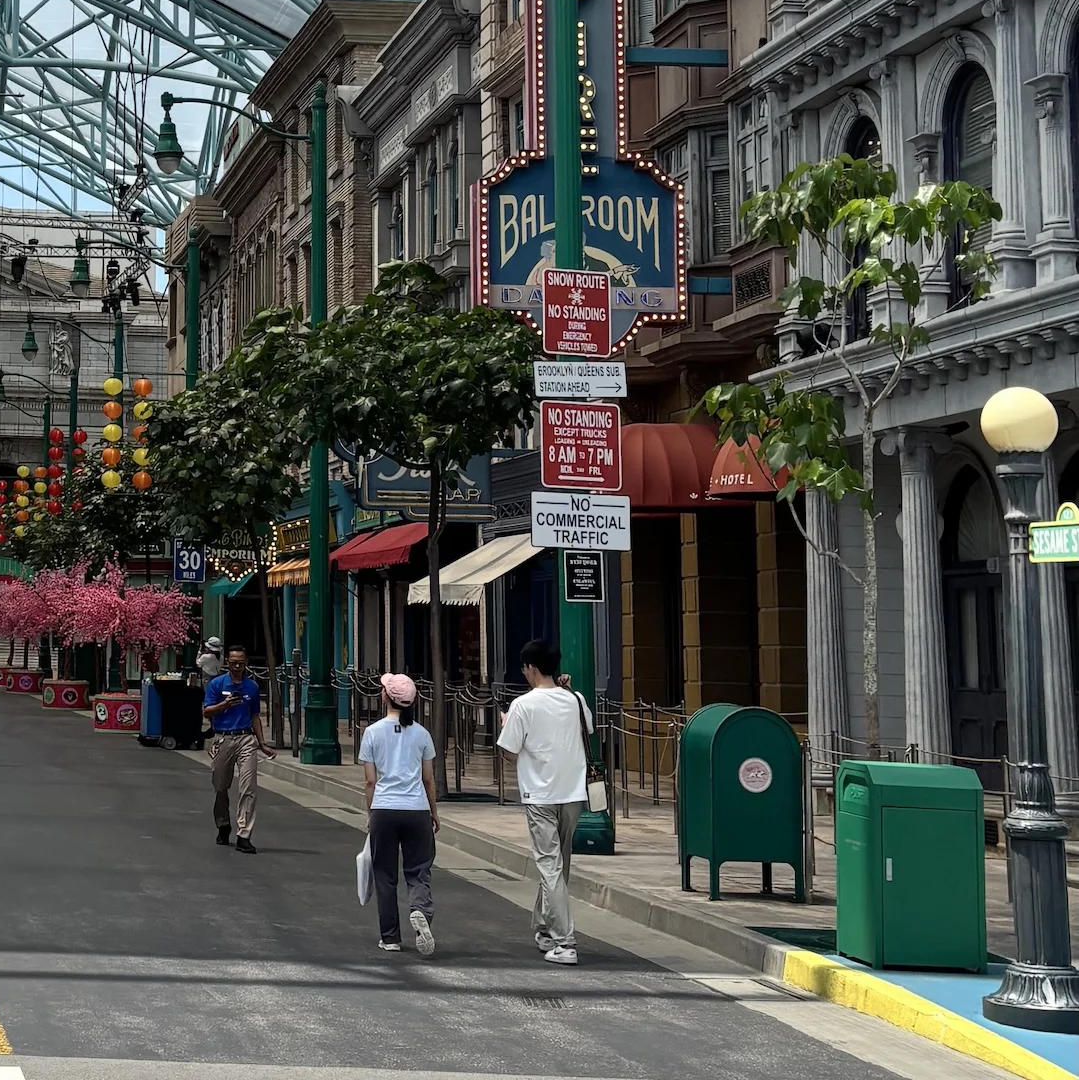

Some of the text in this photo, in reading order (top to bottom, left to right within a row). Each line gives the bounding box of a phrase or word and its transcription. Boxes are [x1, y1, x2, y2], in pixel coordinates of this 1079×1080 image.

[499, 194, 661, 272] BALROOM
[548, 273, 605, 289] SNOW ROUTE
[502, 286, 663, 307] DANG
[548, 305, 606, 321] NO STANDING
[563, 331, 592, 340] EMERGENCY
[538, 366, 573, 376] BROOKLYN
[577, 366, 603, 376] QUEENS
[540, 382, 590, 392] STATION AHEAD
[548, 408, 612, 428] NO STANDING
[554, 427, 607, 438] EXCEPT TRUCKS
[549, 445, 555, 462] 8
[558, 446, 576, 463] AM
[588, 448, 594, 464] 7
[597, 448, 613, 465] PM
[720, 473, 754, 486] HOTEL
[571, 497, 590, 512] NO
[536, 512, 626, 529] COMMERCIAL
[553, 529, 609, 545] TRAFFIC
[1033, 528, 1079, 554] SESAME S
[179, 550, 201, 571] 30
